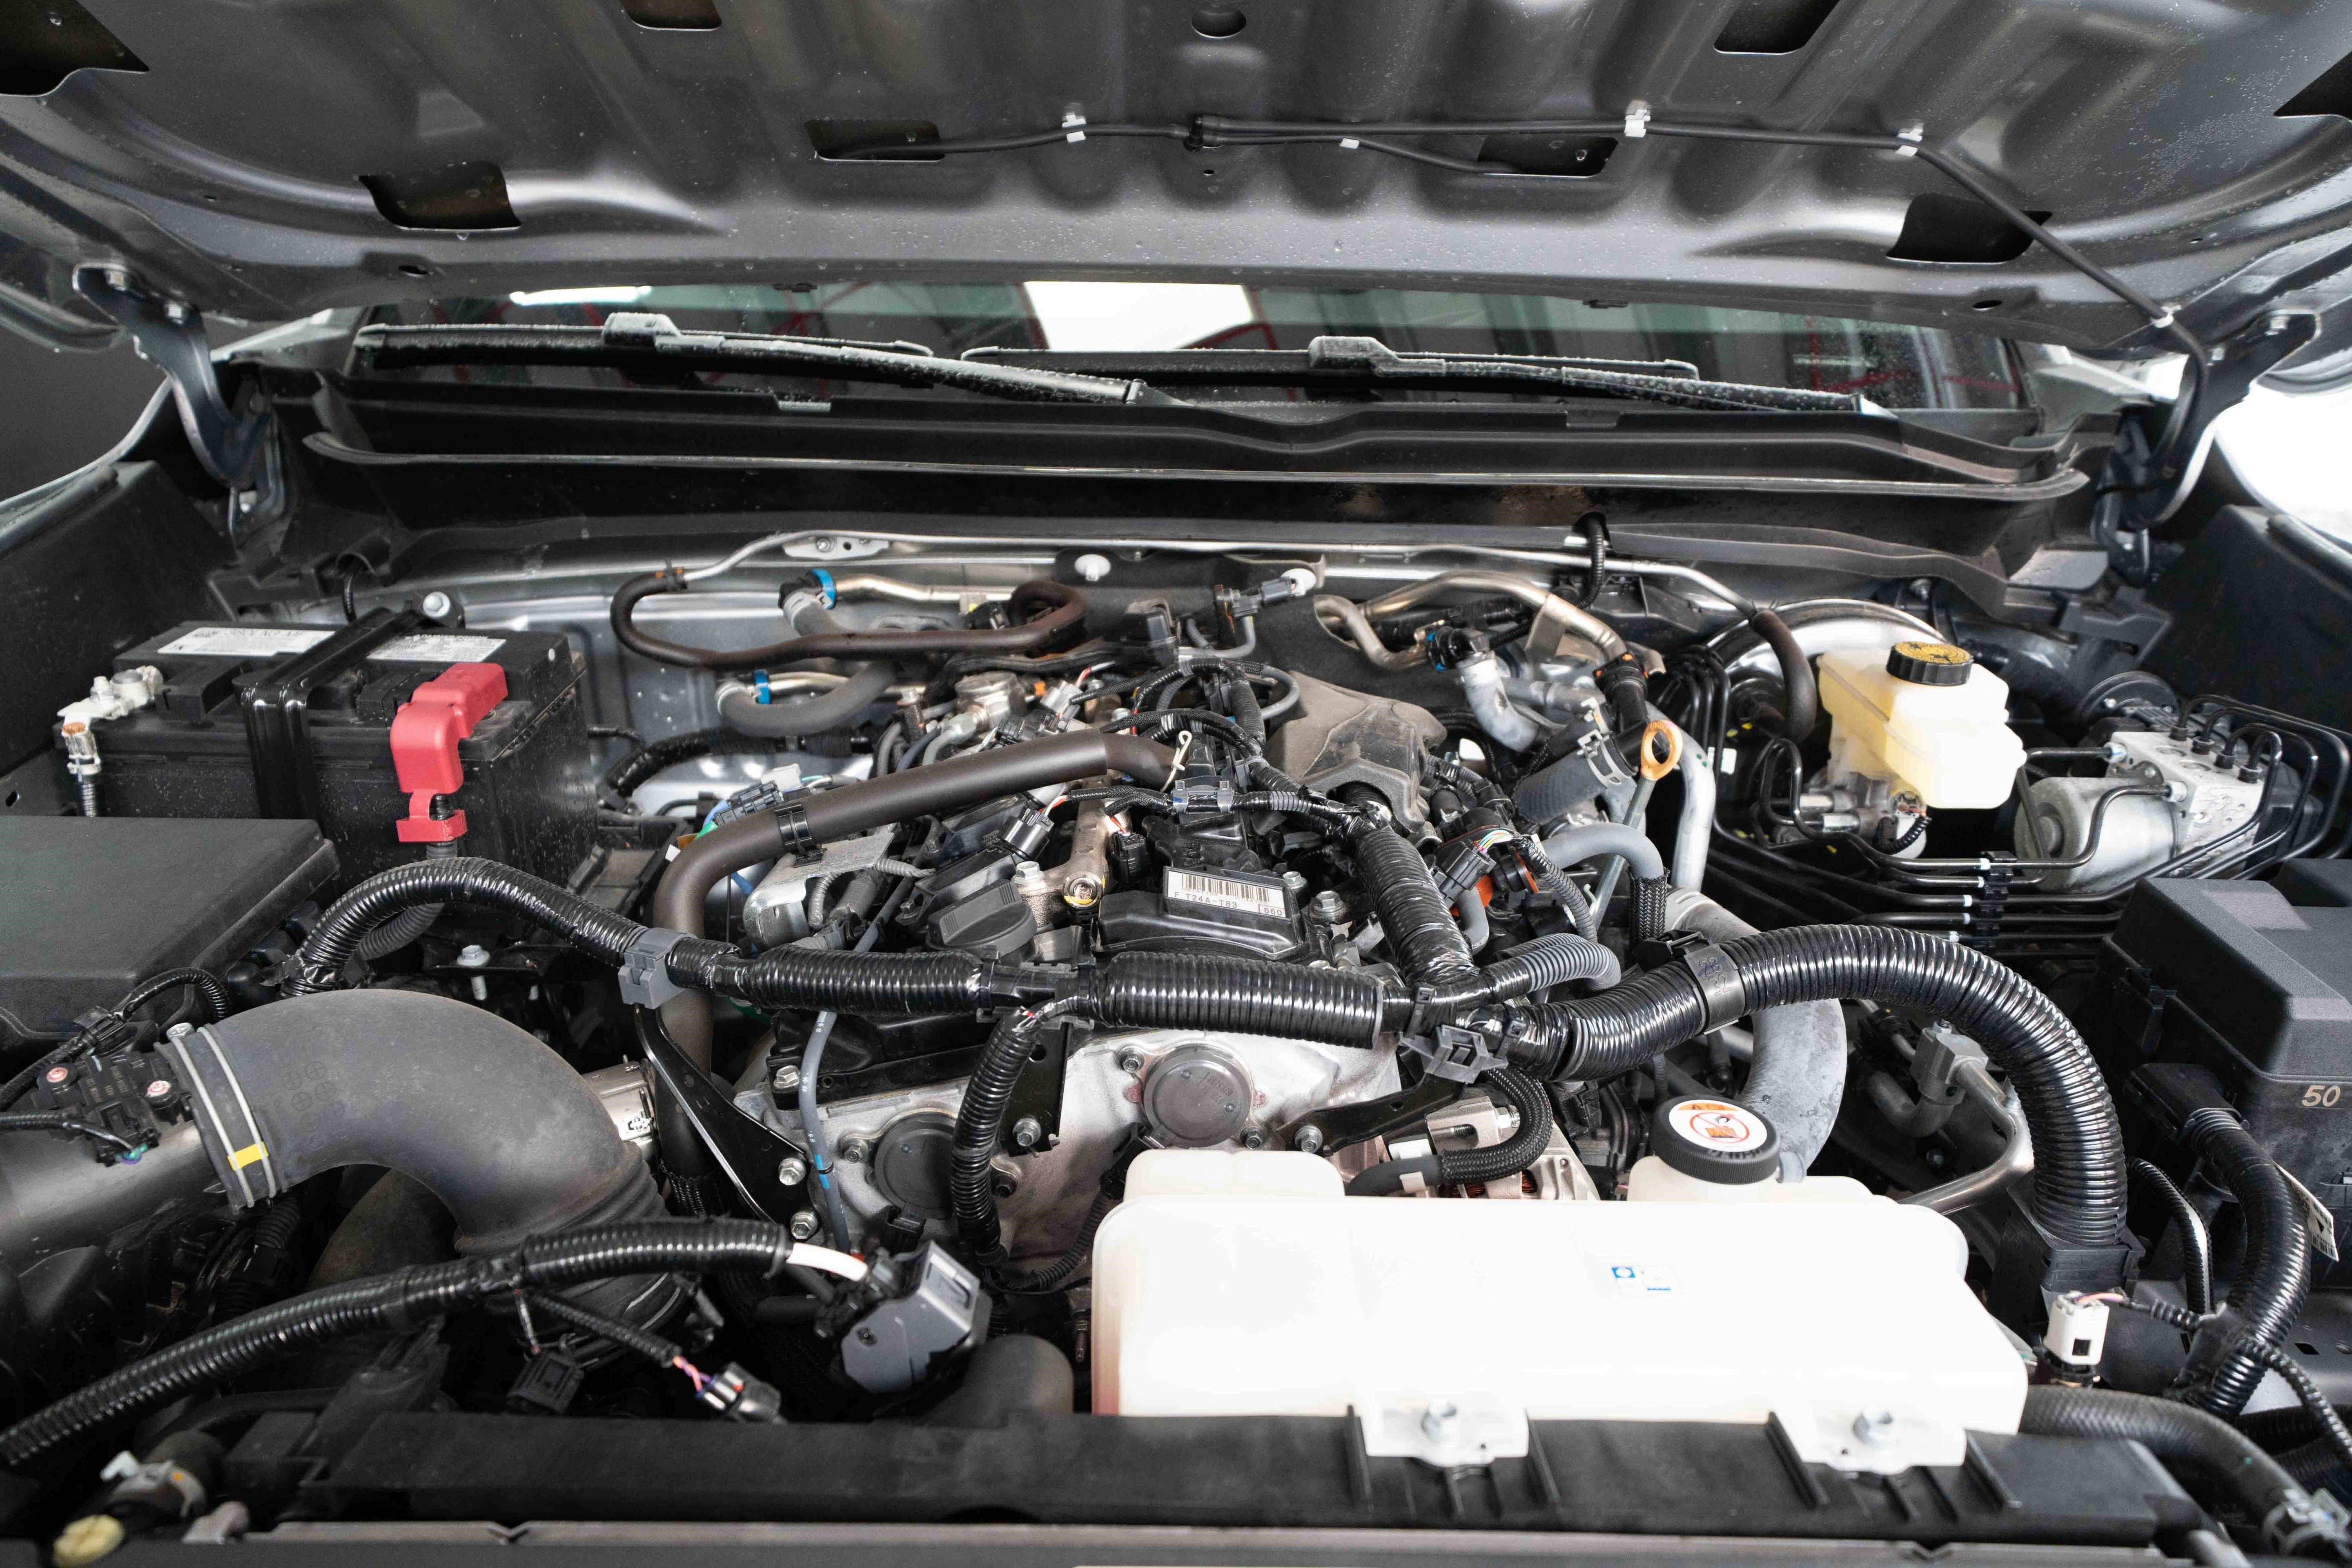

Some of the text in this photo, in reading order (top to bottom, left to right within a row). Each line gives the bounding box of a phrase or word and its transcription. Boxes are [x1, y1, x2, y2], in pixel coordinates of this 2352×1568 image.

[1187, 893, 1238, 909] T24A-T83
[1264, 907, 1283, 916] 660
[2302, 1085, 2340, 1107] 50
